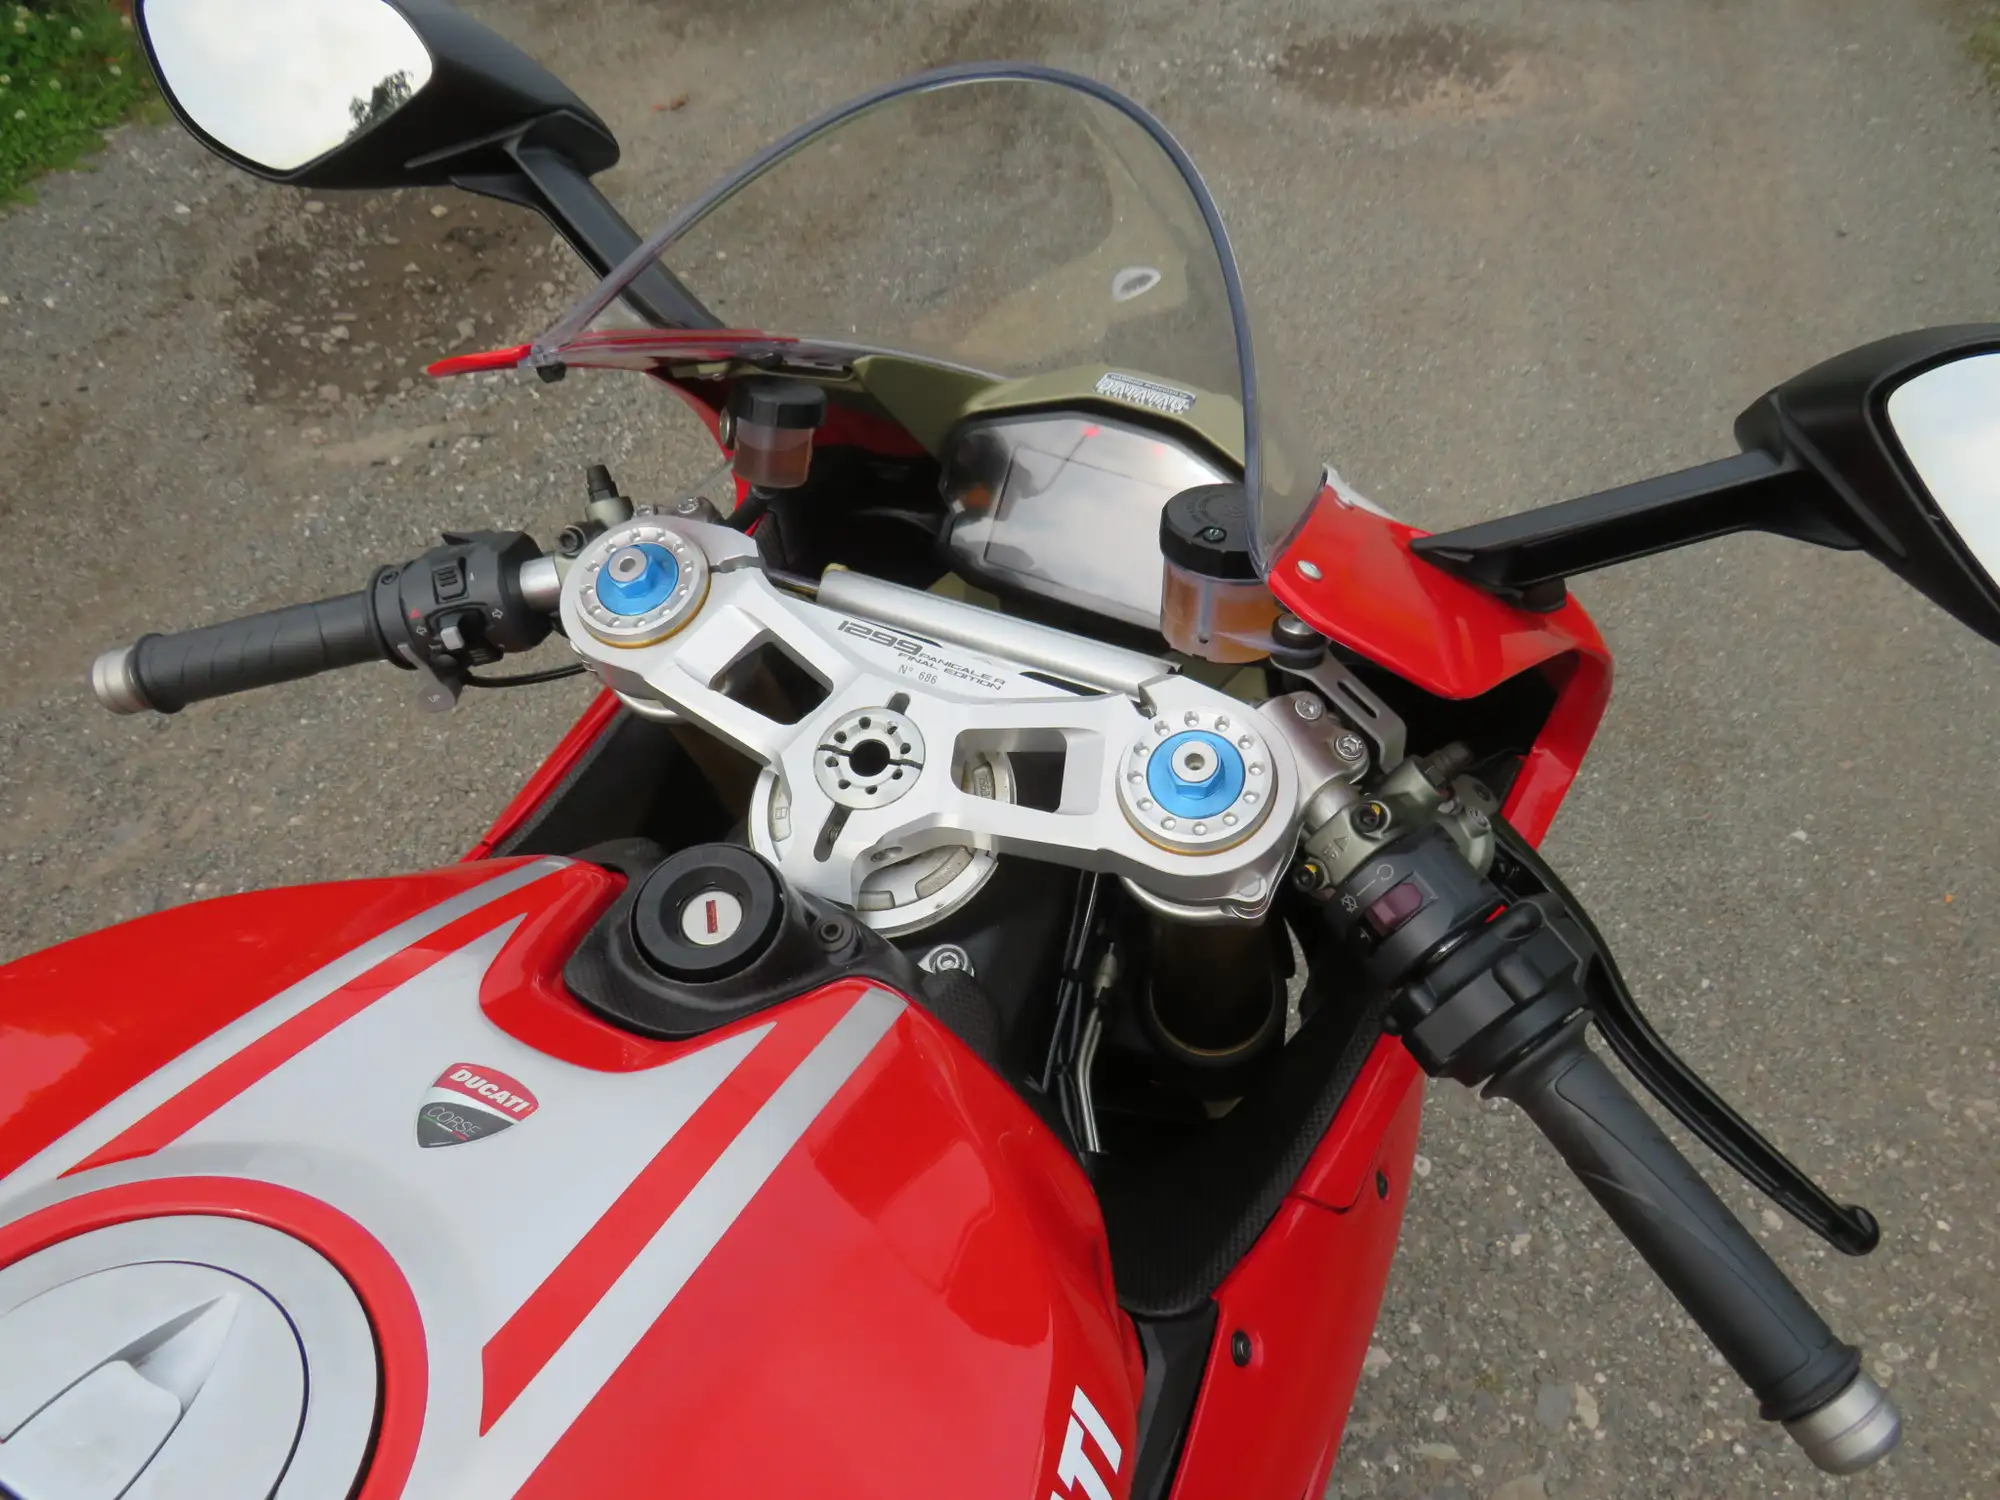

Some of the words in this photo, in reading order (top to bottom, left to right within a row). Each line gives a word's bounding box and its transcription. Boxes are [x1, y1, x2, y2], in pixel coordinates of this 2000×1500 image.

[837, 620, 924, 655] 1299
[898, 652, 940, 671] FINAL
[943, 667, 1002, 691] EDITION
[918, 671, 938, 685] 686
[449, 1069, 530, 1113] DUCATI
[427, 1106, 482, 1138] CORSE
[1049, 1384, 1122, 1500] TI
